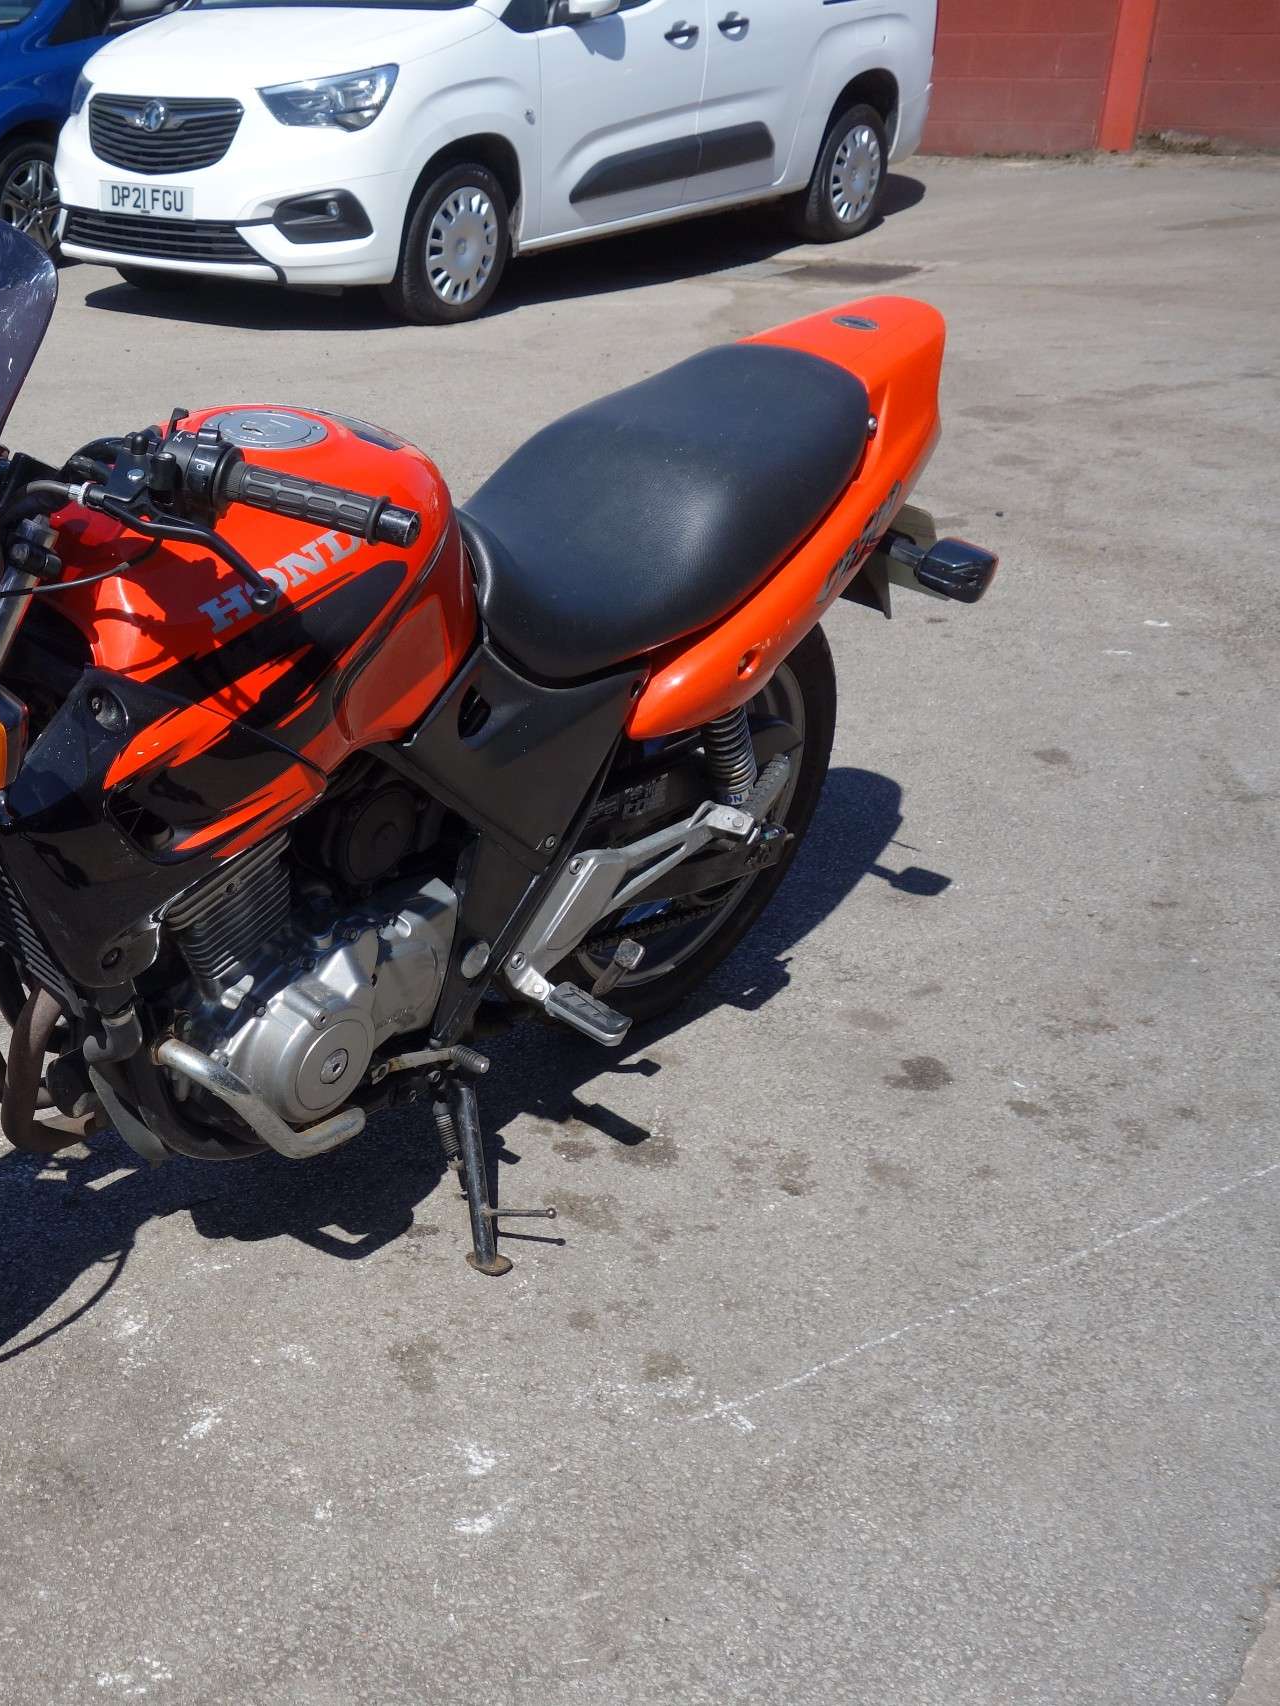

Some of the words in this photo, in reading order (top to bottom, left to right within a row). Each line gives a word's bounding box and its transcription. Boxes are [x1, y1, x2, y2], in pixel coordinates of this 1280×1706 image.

[111, 185, 146, 210] DP21
[151, 188, 184, 212] FGU
[198, 528, 371, 634] HOND
